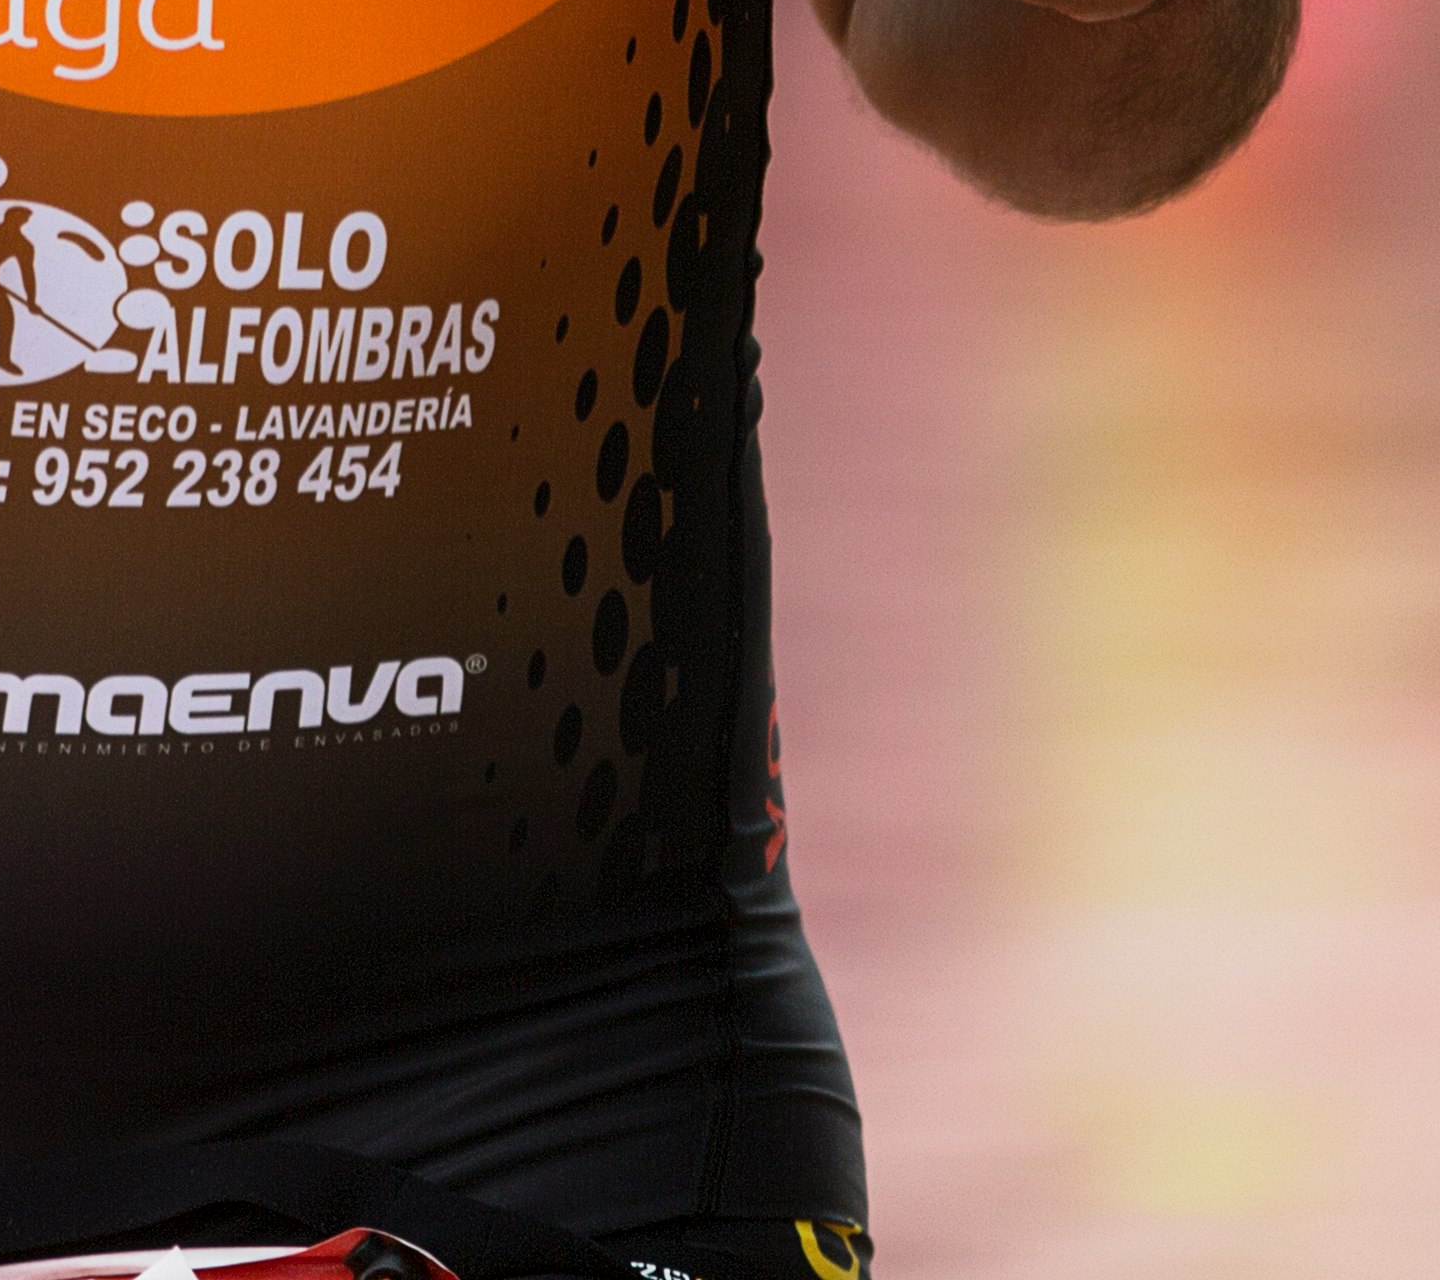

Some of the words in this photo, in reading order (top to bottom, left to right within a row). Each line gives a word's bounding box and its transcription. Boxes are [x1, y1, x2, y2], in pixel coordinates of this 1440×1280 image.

[154, 209, 388, 290] SOLO
[136, 298, 500, 386] ALFOMBRAS
[11, 402, 70, 439] EN
[82, 403, 197, 442] SECO
[235, 388, 472, 441] LAVANDERÍA
[32, 446, 149, 508] 952
[166, 448, 281, 507] 238
[298, 441, 402, 502] 454
[238, 740, 270, 752] DE
